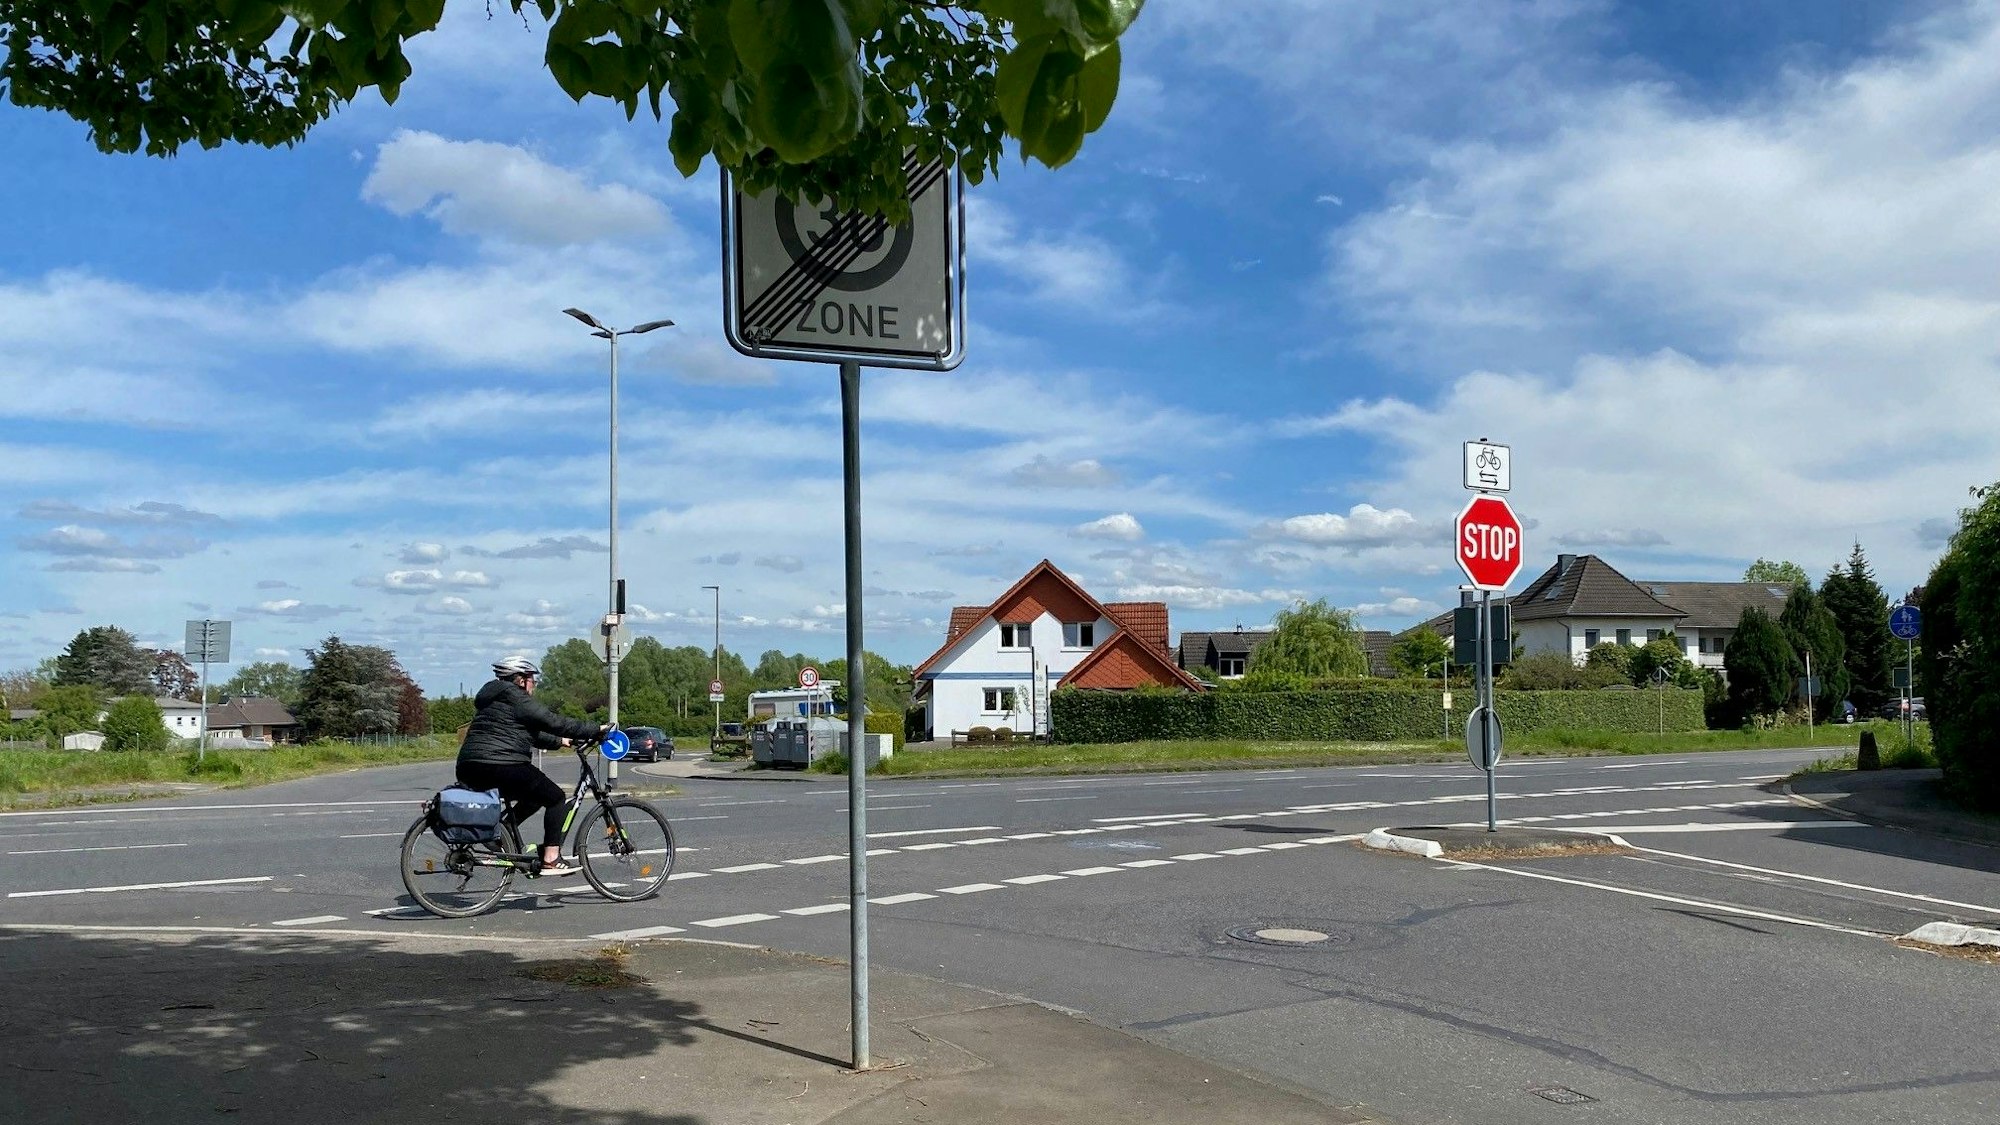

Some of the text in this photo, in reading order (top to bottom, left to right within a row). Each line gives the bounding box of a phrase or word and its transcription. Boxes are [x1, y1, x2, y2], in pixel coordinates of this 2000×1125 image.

[796, 300, 900, 340] ZONE
[1464, 522, 1517, 562] STOP
[803, 672, 815, 683] 30
